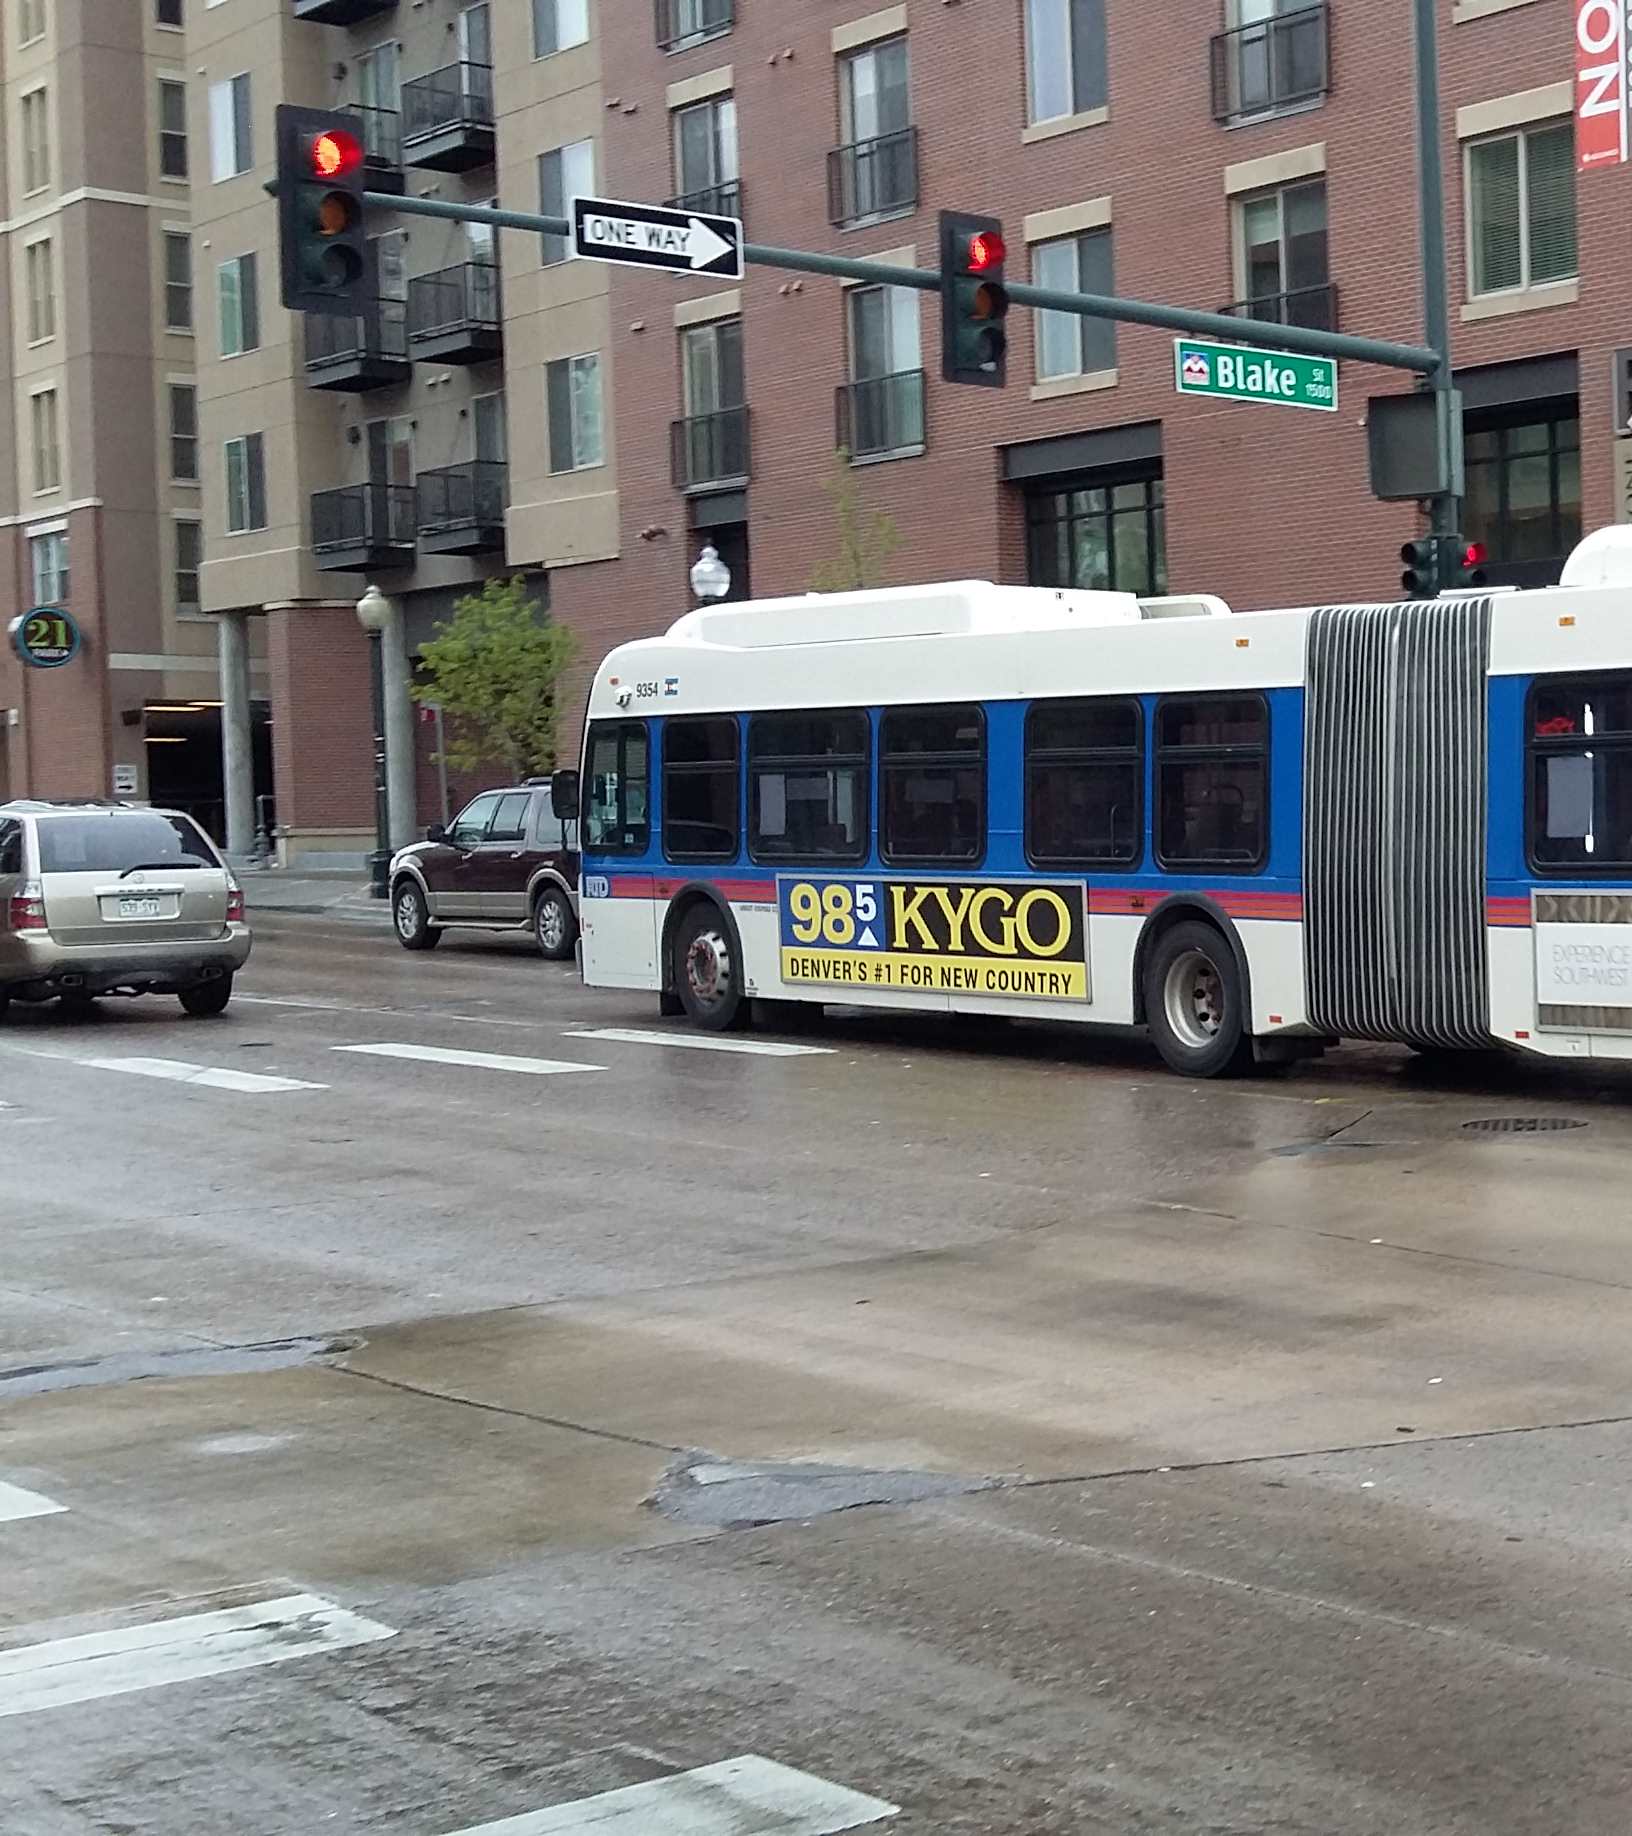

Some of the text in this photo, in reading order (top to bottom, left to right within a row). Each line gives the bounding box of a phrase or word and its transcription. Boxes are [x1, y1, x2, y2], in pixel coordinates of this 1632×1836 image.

[591, 219, 690, 251] ONE WAY
[1216, 355, 1297, 396] Blake
[27, 619, 69, 647] 21
[636, 681, 659, 698] 9354
[890, 886, 1071, 957] KYGO
[790, 958, 1072, 995] DENVER'S #1 FOR NEW COUNTRY
